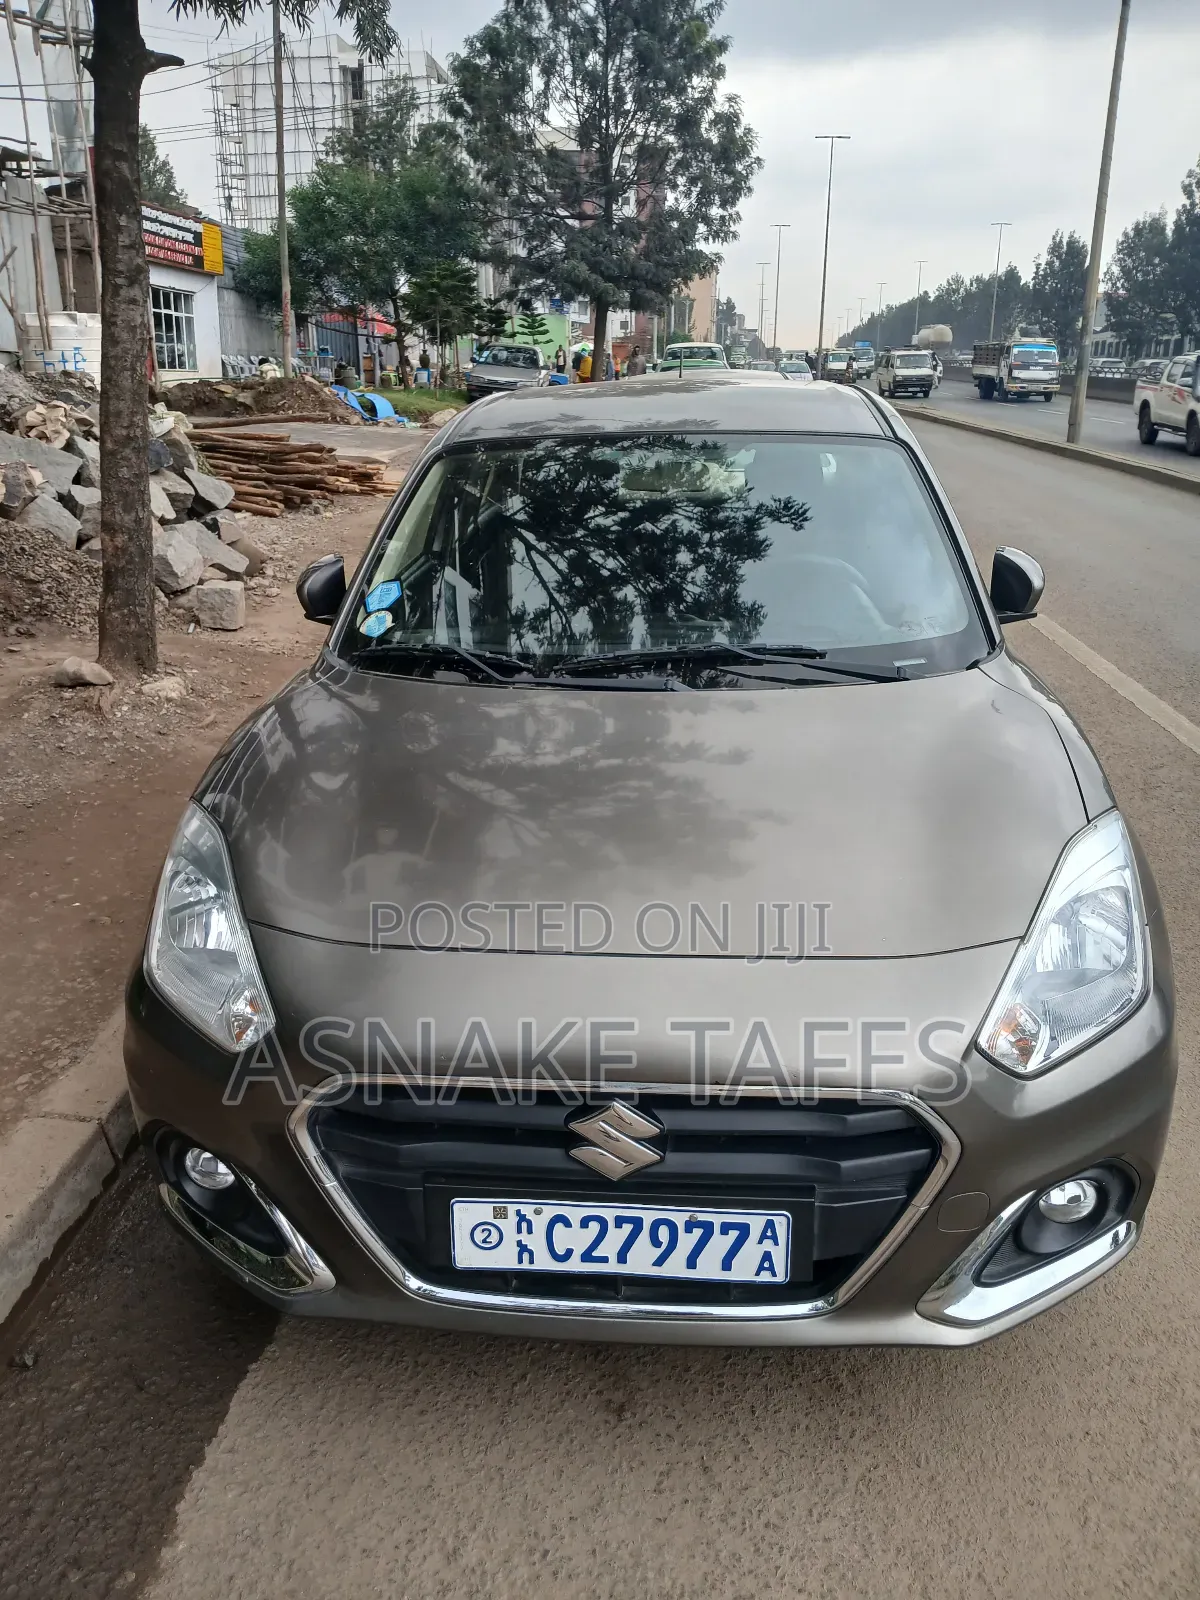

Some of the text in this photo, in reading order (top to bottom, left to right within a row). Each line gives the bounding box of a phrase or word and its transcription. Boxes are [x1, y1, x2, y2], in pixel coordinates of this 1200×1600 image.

[546, 1213, 751, 1271] C27977
[757, 1218, 780, 1247] A
[754, 1250, 777, 1277] A
